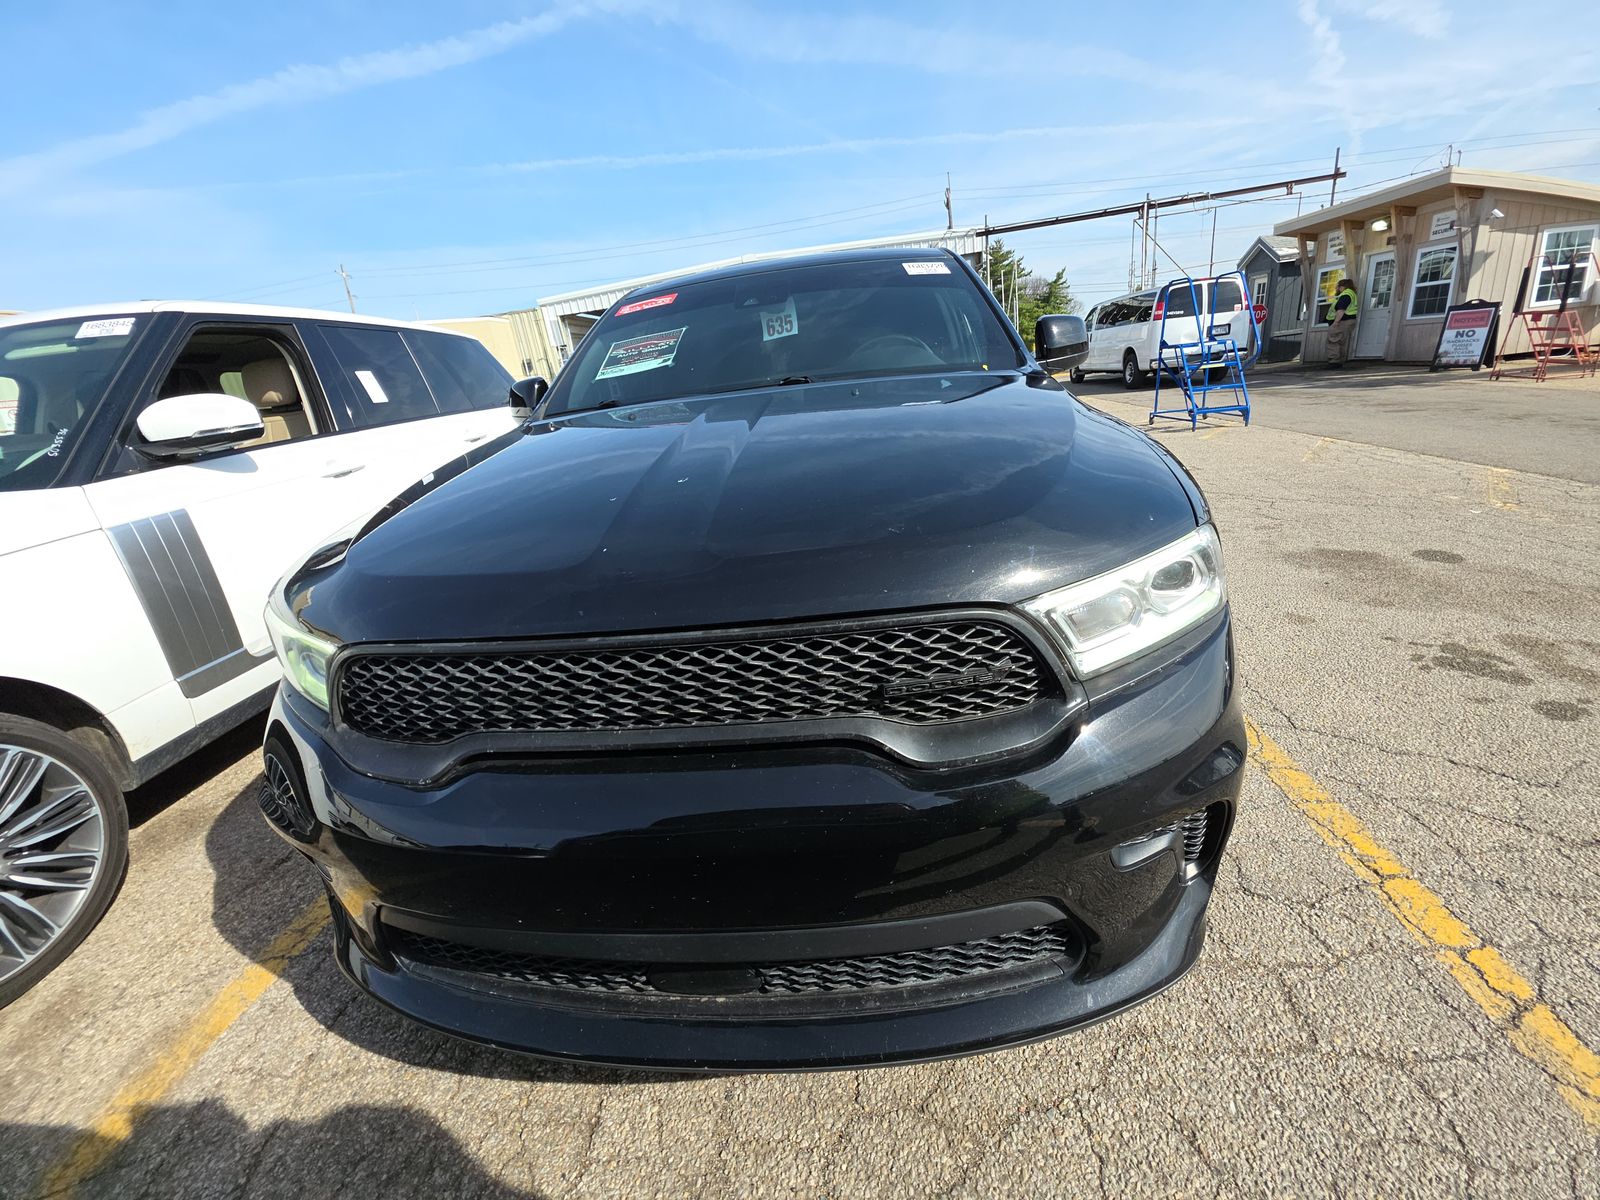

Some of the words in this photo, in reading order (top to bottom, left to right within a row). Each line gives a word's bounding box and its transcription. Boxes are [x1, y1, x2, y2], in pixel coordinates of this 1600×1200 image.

[766, 314, 793, 336] 635
[1455, 330, 1476, 338] NO
[642, 344, 669, 352] GROUP
[884, 673, 993, 696] DODGE
